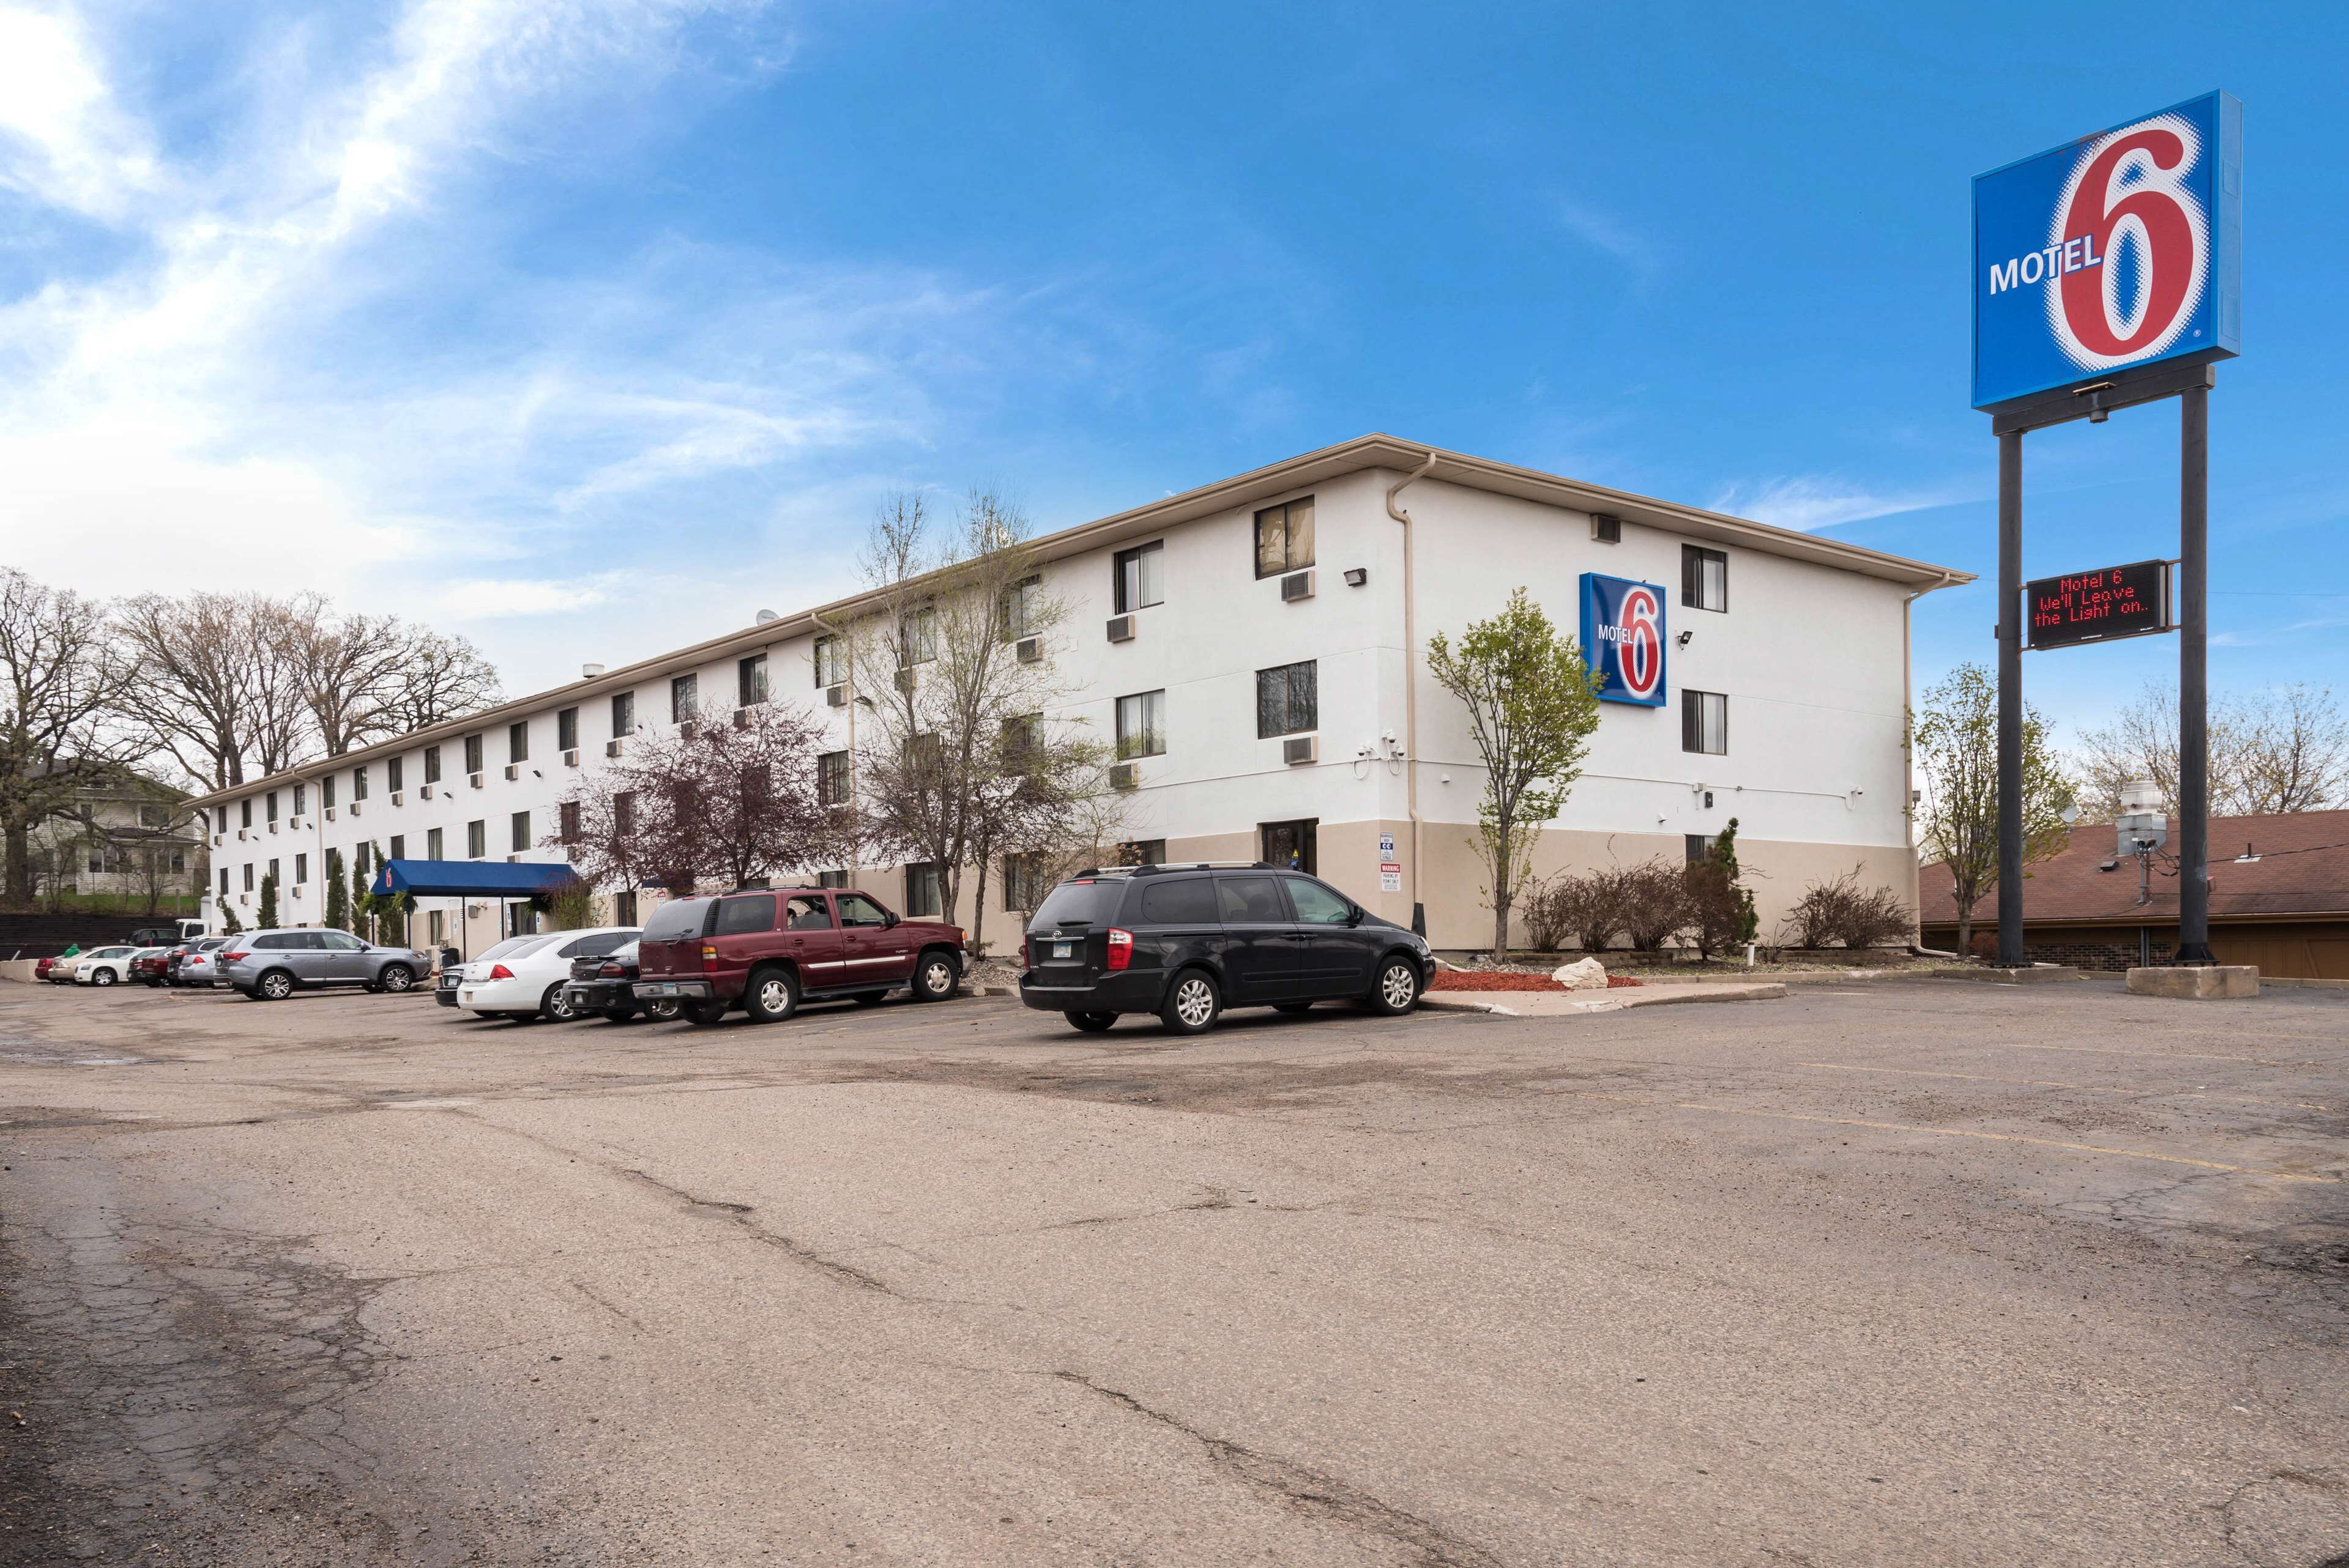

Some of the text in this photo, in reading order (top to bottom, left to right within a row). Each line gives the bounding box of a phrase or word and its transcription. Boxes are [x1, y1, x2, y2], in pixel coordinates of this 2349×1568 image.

[1990, 125, 2197, 360] MOTEL 6
[2060, 568, 2123, 593] Motel 6
[2039, 587, 2134, 611] We'll Leave
[2034, 612, 2060, 626] the
[2070, 602, 2110, 622] Light
[1598, 590, 1659, 693] MOTEL 6
[385, 867, 392, 888] 6
